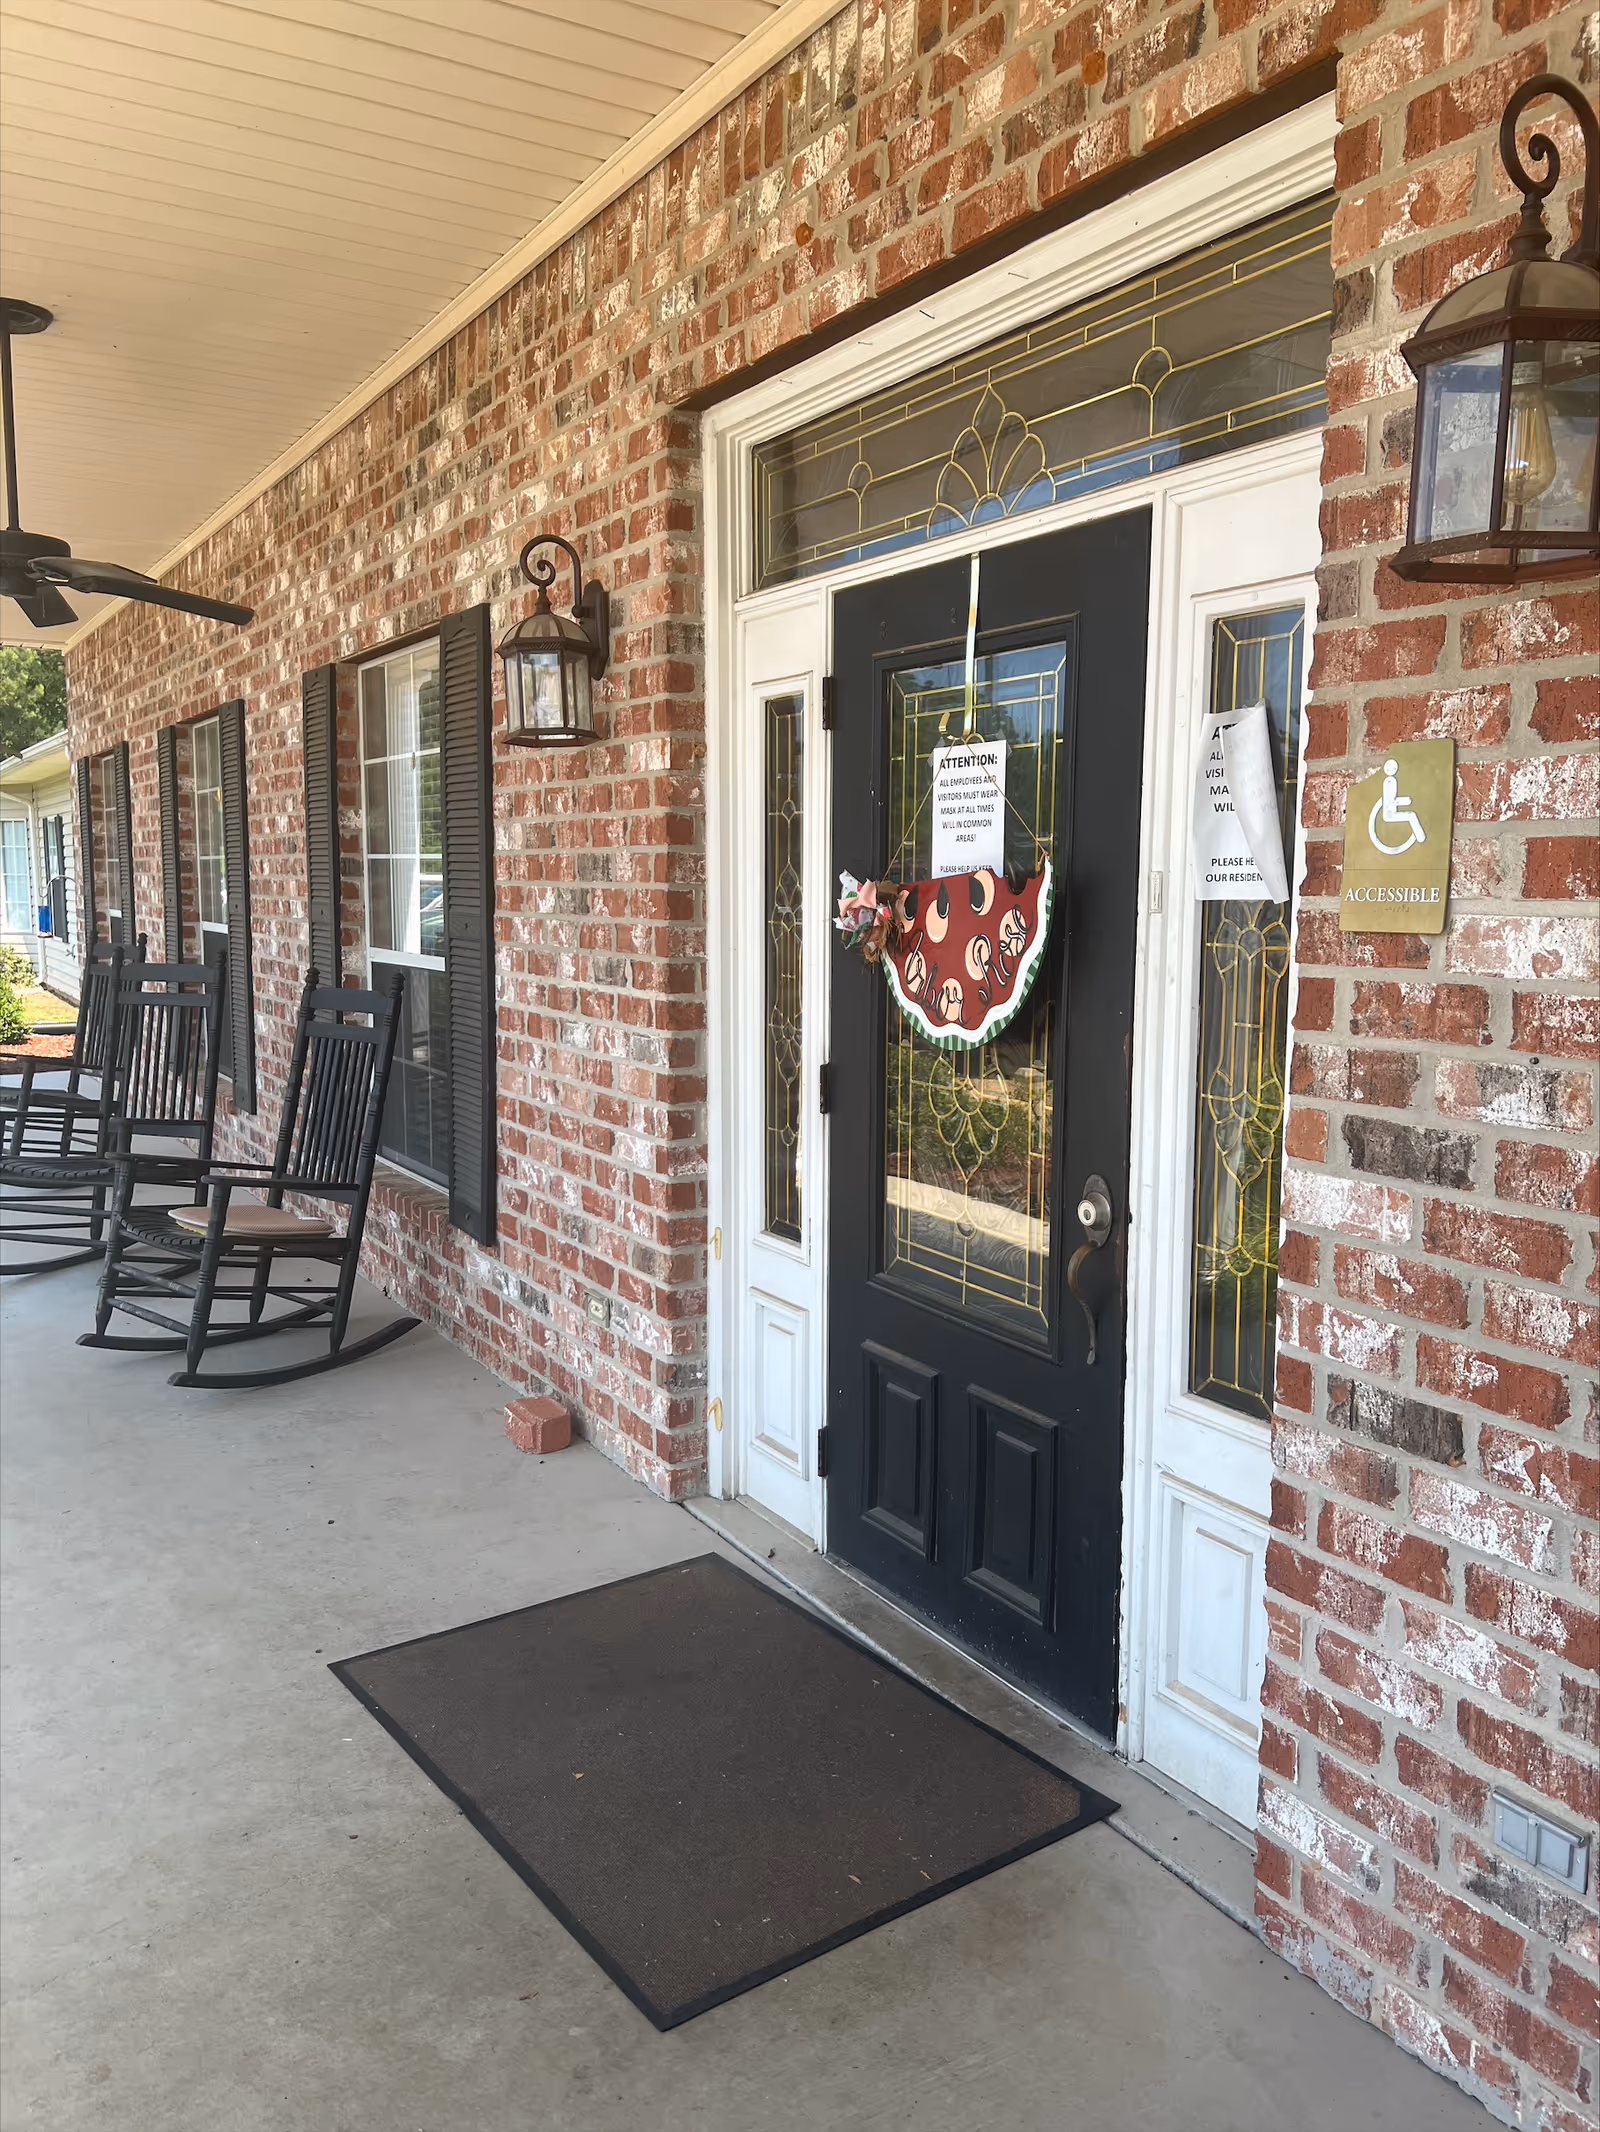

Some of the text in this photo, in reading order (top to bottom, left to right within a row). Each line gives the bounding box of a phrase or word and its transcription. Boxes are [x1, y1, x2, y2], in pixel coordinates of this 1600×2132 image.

[941, 754, 998, 769] ATTENTION:
[1210, 752, 1223, 761] AL
[940, 775, 996, 787] ALL EMPLOYEES AND
[938, 790, 998, 801] VISITORS MUST WEAR
[941, 805, 994, 815] MASK AT ALL TIMES
[942, 819, 992, 829] WILL IN COMMON
[956, 834, 976, 842] AREAS!
[1212, 858, 1243, 867] PLEASE
[958, 865, 970, 873] HELP
[1206, 873, 1227, 882] OUR
[1345, 888, 1440, 902] ACCESSIBLE
[972, 904, 1033, 1006] Rose
